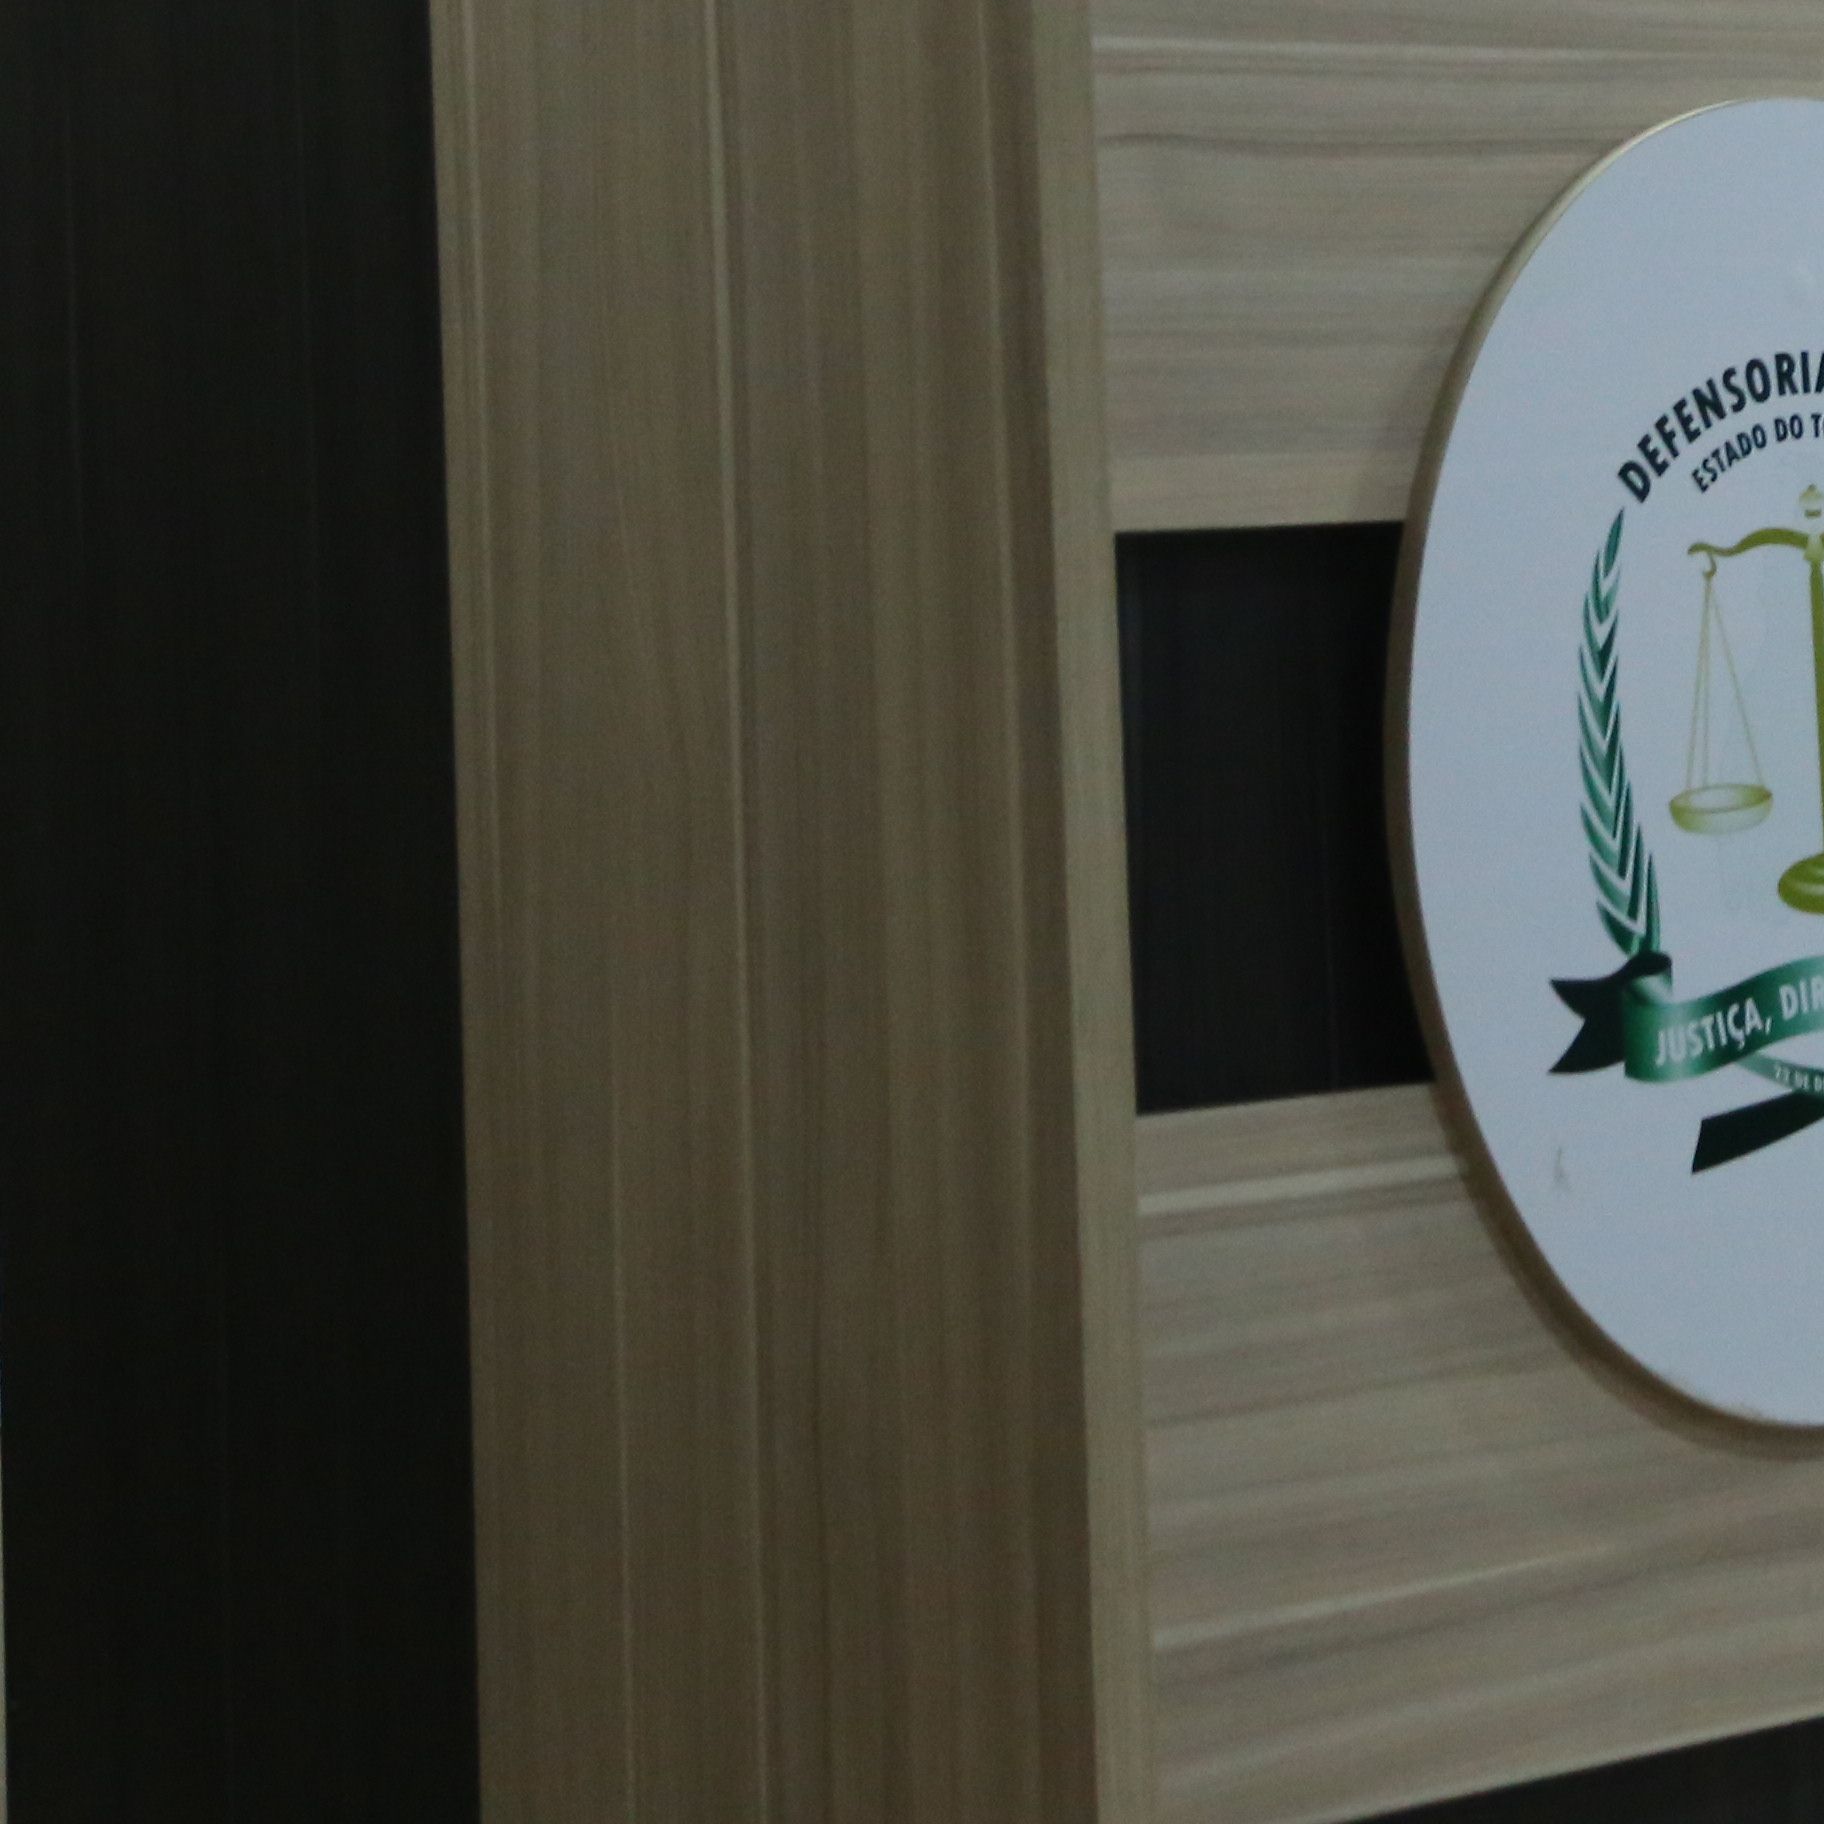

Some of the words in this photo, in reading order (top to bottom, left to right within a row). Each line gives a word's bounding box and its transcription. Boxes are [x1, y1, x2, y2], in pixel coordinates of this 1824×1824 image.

[1690, 423, 1767, 493] ESTADO
[1774, 414, 1803, 442] DO
[1655, 997, 1772, 1068] JUSTIÇA,
